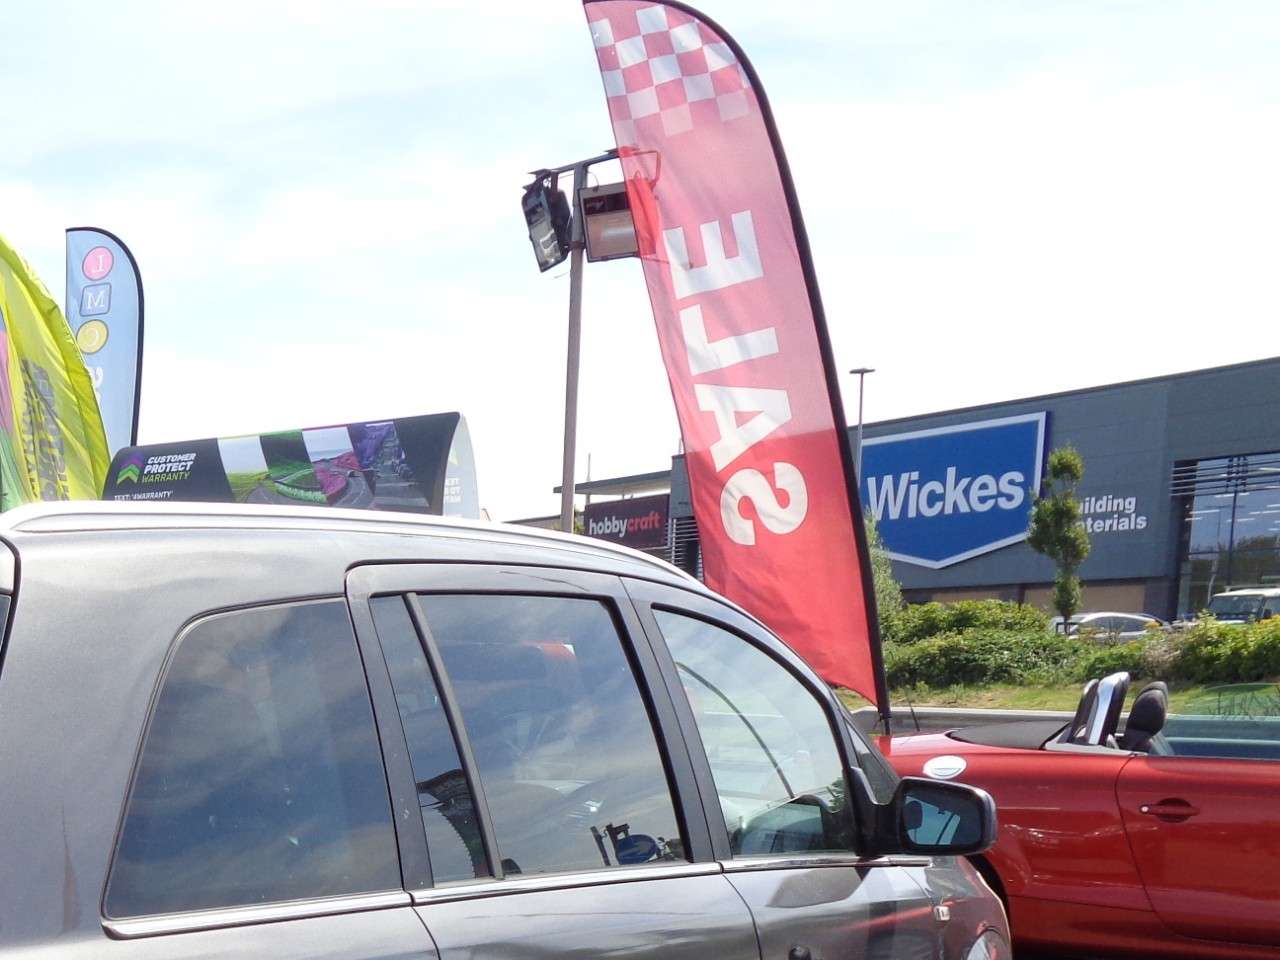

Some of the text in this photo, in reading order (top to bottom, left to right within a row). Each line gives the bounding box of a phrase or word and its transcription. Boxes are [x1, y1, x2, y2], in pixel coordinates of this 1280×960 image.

[144, 461, 194, 474] PROTECT
[148, 453, 196, 464] CUSTOMER
[142, 471, 191, 483] WARRANTY
[867, 466, 1025, 521] Wickes
[1078, 495, 1137, 514] ilding
[588, 511, 660, 537] hobbycraft
[1075, 513, 1147, 533] aterials
